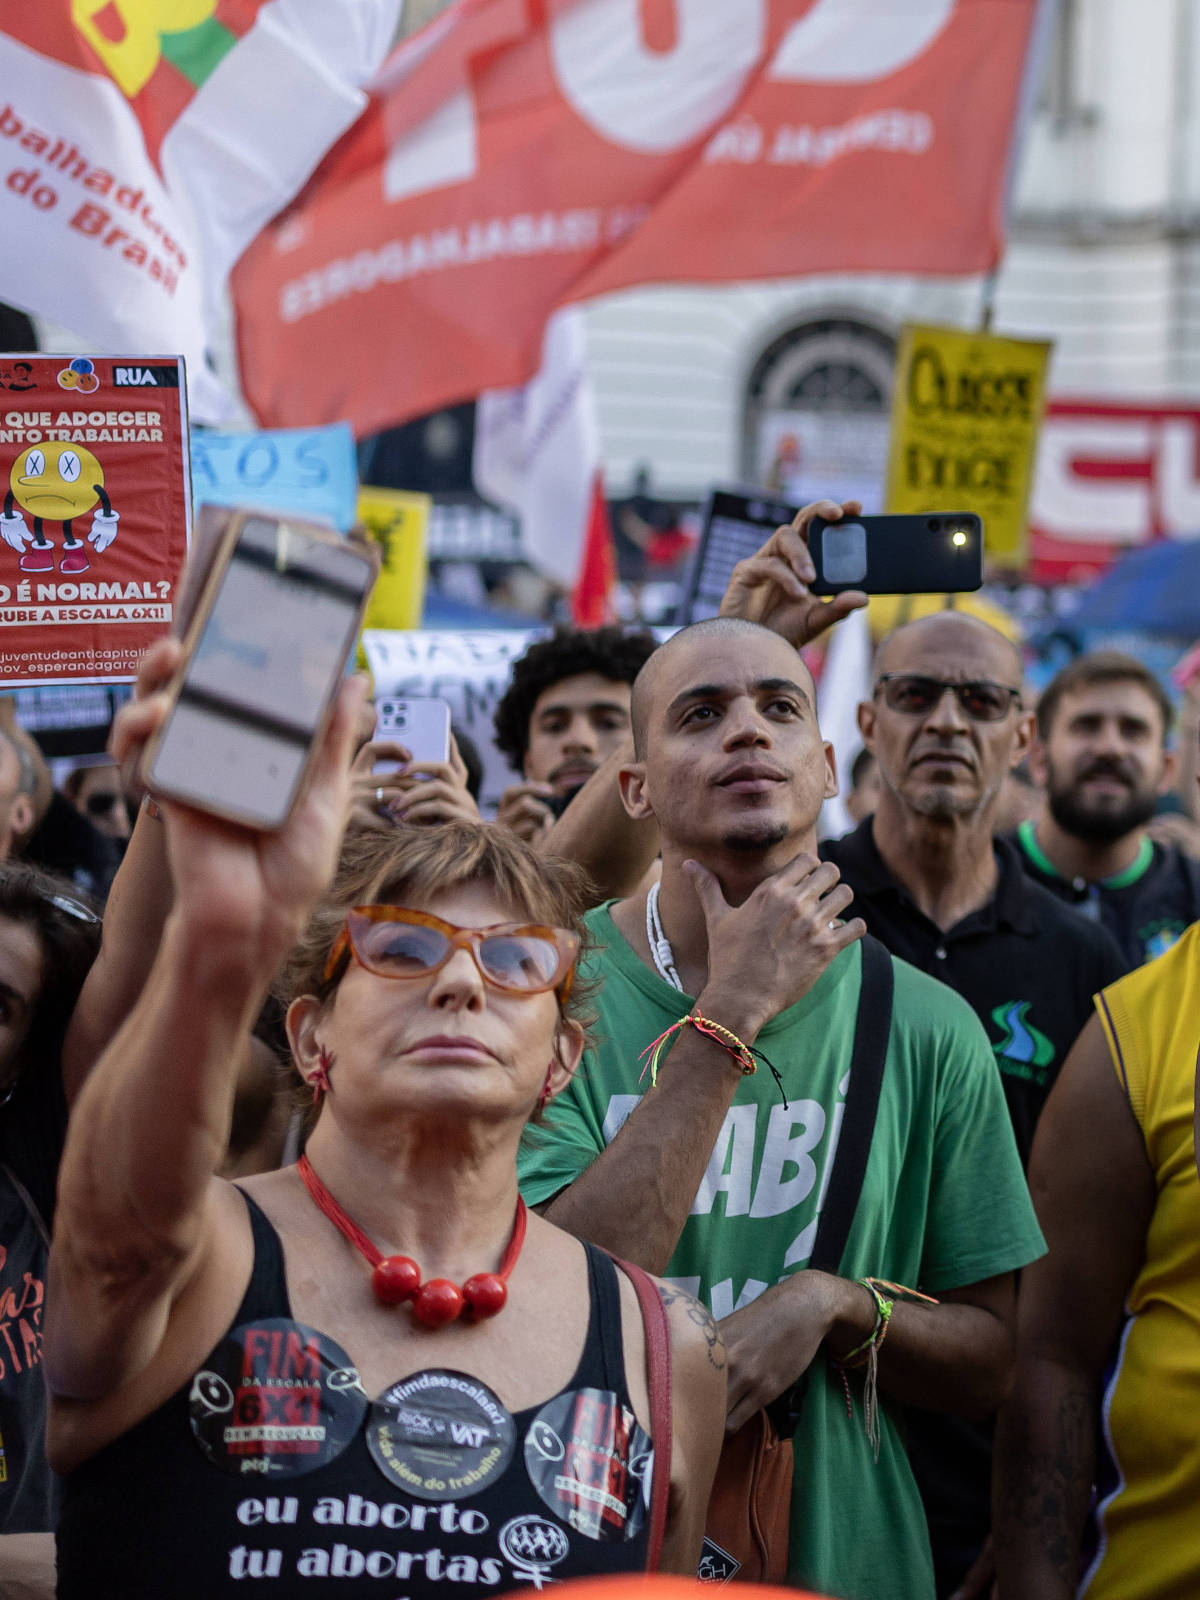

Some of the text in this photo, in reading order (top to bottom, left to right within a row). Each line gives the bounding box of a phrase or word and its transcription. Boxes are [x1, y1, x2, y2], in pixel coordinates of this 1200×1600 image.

[5, 168, 178, 299] do Brasil
[115, 368, 157, 386] RUA
[5, 411, 161, 428] QUE ADOECER
[46, 429, 164, 443] TRABALHAR
[17, 580, 31, 602] É
[37, 581, 171, 602] NORMAL?
[42, 608, 55, 622] A
[58, 608, 129, 621] ESCALA
[132, 607, 164, 619] 6X1!
[242, 1329, 321, 1378] FIM
[424, 1477, 446, 1491] do
[237, 1494, 490, 1535] eu aborto
[229, 1543, 504, 1585] tu abortas
